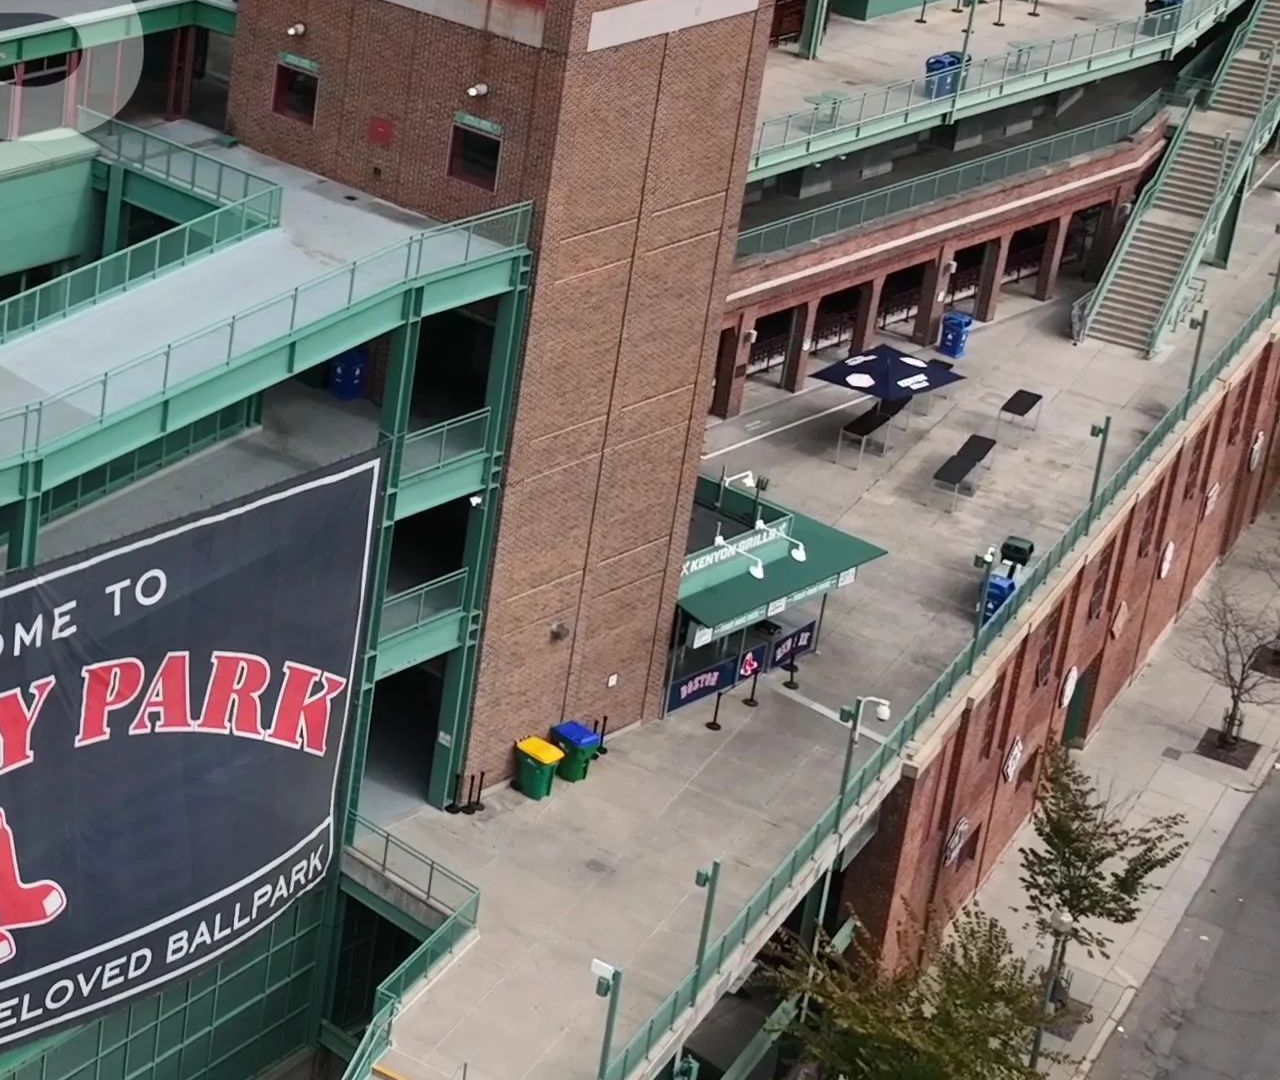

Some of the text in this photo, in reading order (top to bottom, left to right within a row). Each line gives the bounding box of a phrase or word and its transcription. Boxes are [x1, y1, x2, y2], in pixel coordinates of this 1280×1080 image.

[104, 568, 169, 617] TO
[690, 544, 737, 573] KENYON
[73, 650, 348, 757] PARK
[165, 841, 328, 963] BALLPARK
